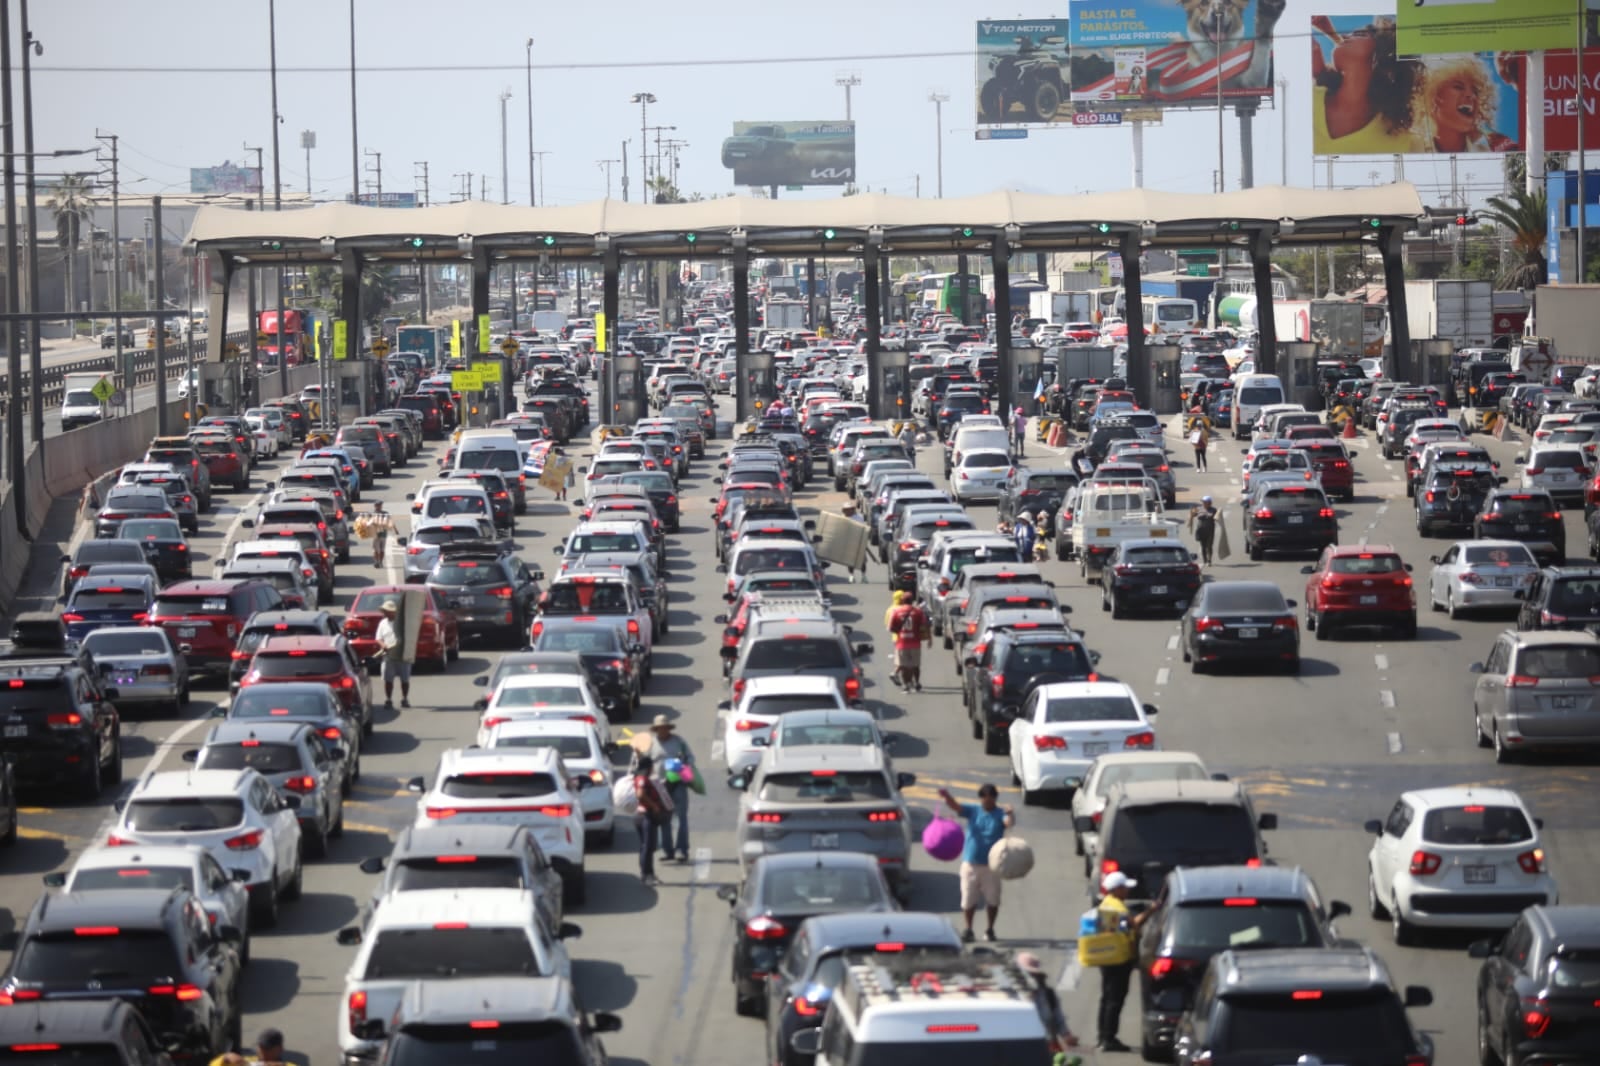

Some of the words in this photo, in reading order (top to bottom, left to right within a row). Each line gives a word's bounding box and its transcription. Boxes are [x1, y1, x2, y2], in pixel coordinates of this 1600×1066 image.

[1080, 10, 1116, 19] BASTA
[1120, 9, 1136, 18] DE
[1544, 75, 1591, 89] UNA
[1544, 98, 1595, 116] BIEN
[1076, 114, 1118, 122] GLOBAL
